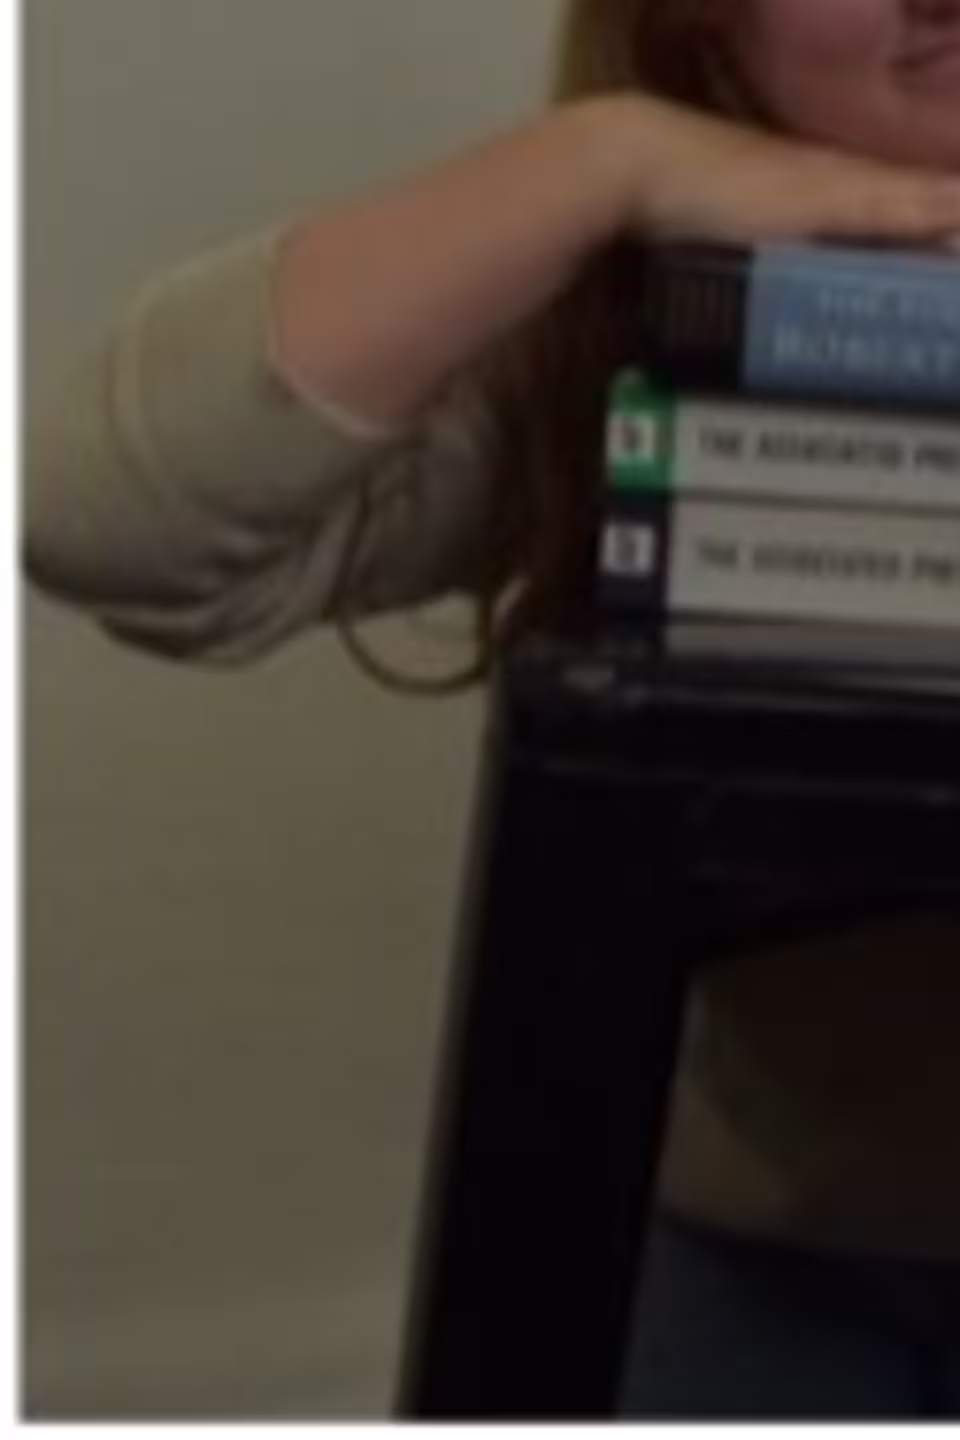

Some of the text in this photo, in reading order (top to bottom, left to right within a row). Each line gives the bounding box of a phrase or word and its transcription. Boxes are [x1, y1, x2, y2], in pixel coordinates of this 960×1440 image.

[772, 320, 958, 376] ROBERT
[701, 429, 743, 458] THE
[757, 431, 900, 472] ASSOCIATED
[698, 537, 739, 568] THE
[752, 543, 900, 580] ASSOCIATED
